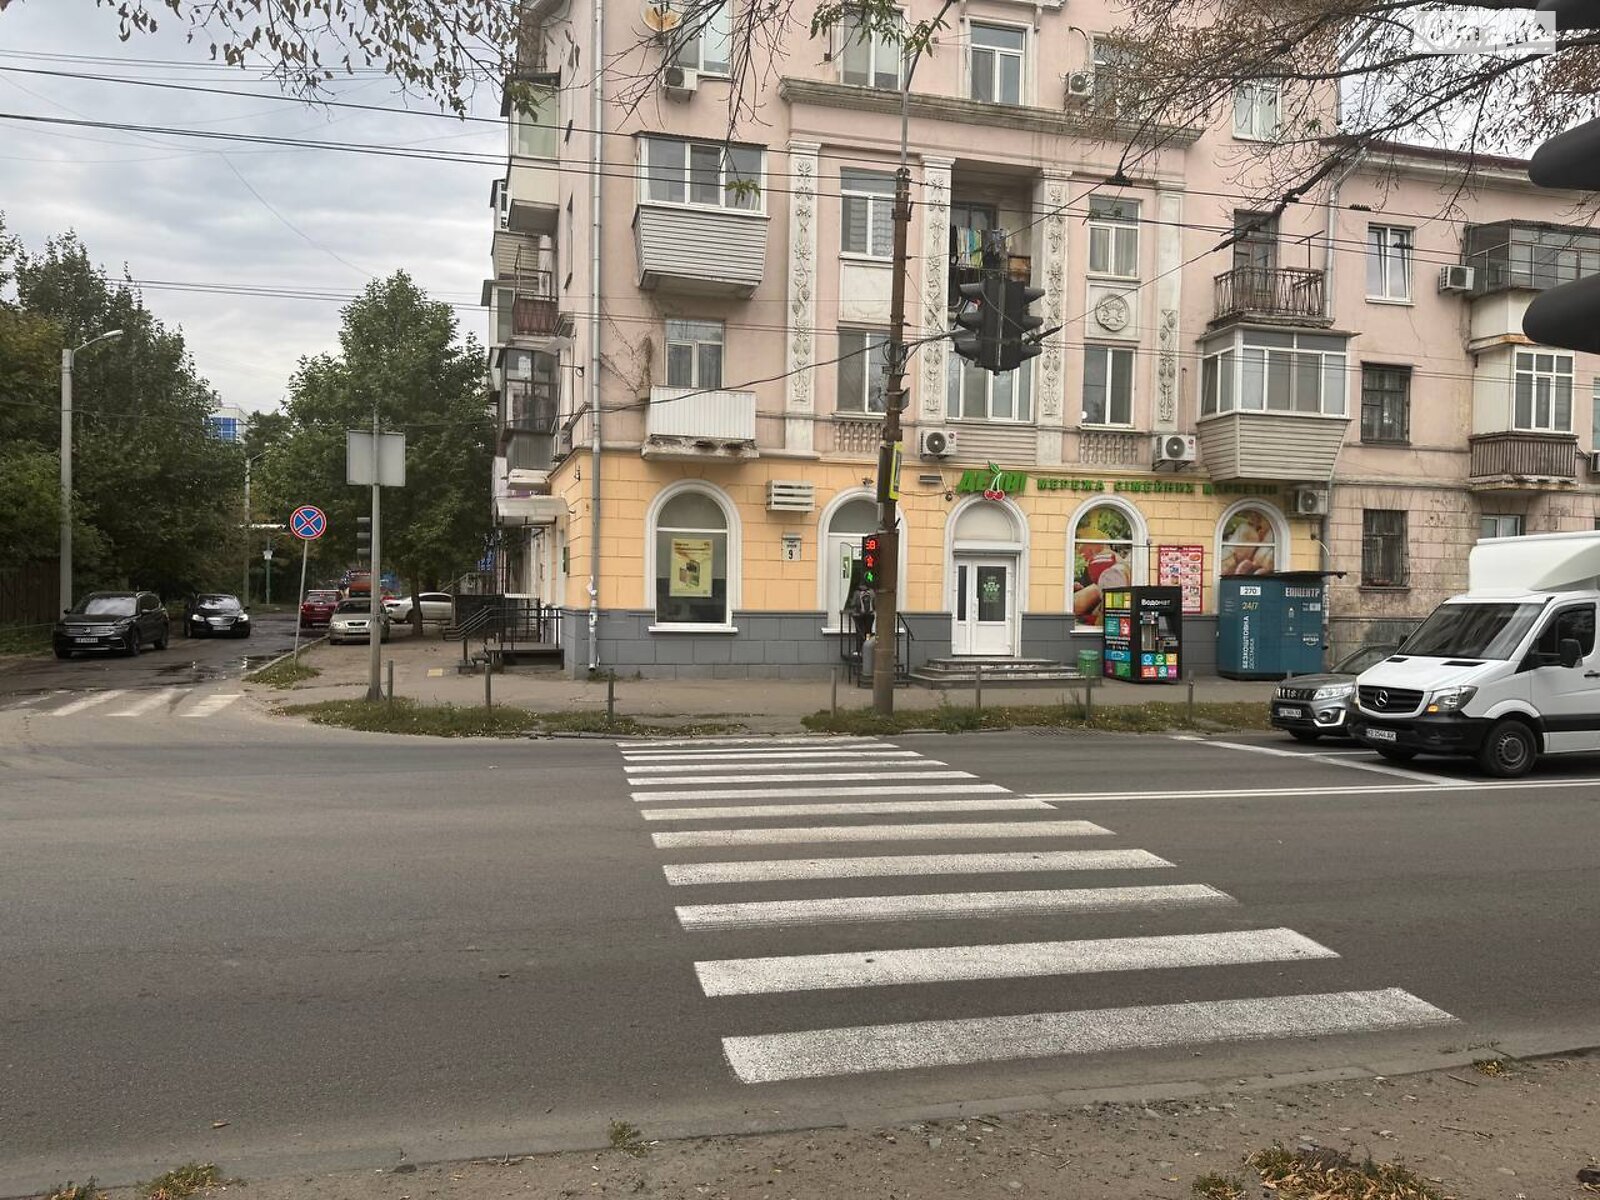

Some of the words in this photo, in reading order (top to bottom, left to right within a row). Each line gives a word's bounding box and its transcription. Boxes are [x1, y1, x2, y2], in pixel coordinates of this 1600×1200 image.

[1037, 478, 1105, 491] МЕРЕЖА
[1113, 479, 1195, 494] СІМЕЙНИХ
[788, 549, 793, 560] 9
[1242, 602, 1258, 611] 24/7
